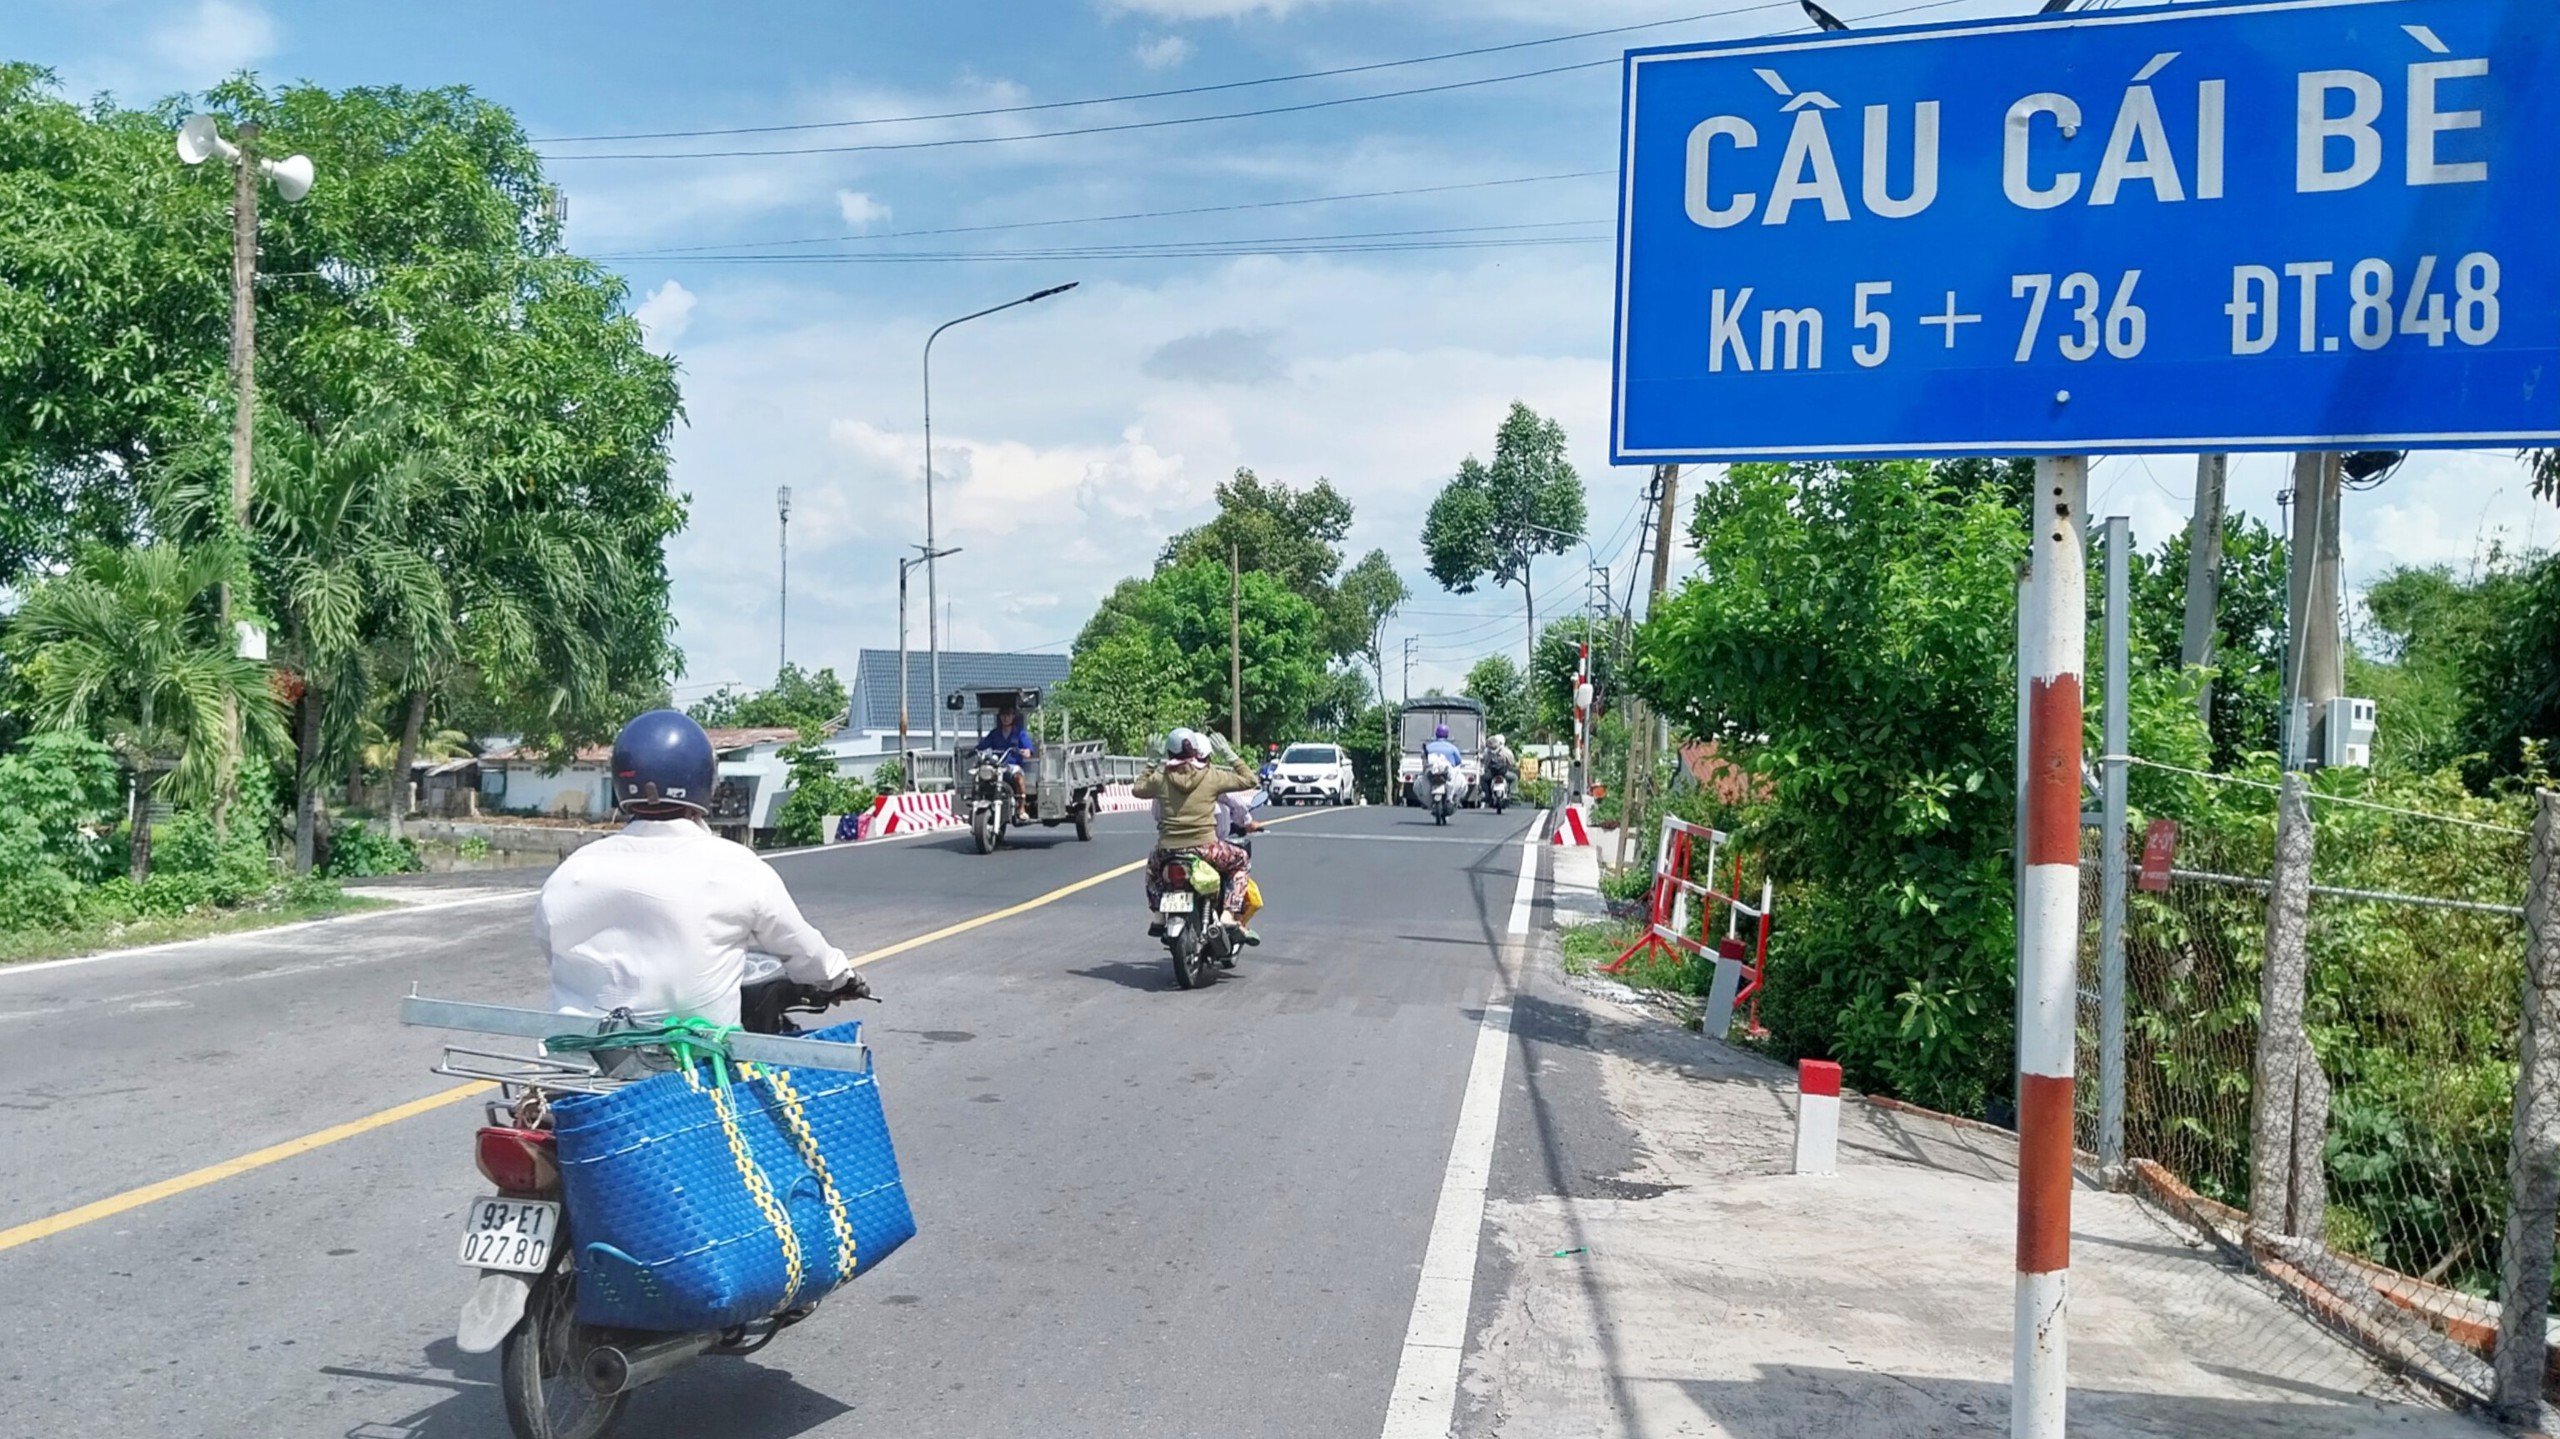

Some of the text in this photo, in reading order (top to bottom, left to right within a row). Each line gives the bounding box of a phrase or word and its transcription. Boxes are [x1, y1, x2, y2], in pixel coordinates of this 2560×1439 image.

[1685, 25, 2489, 229] CẦU CÁI BÈ
[1709, 252, 2500, 372] Km 5 + 736 ĐT.848
[463, 1232, 545, 1267] 027.80
[480, 1202, 544, 1235] 93-E1
